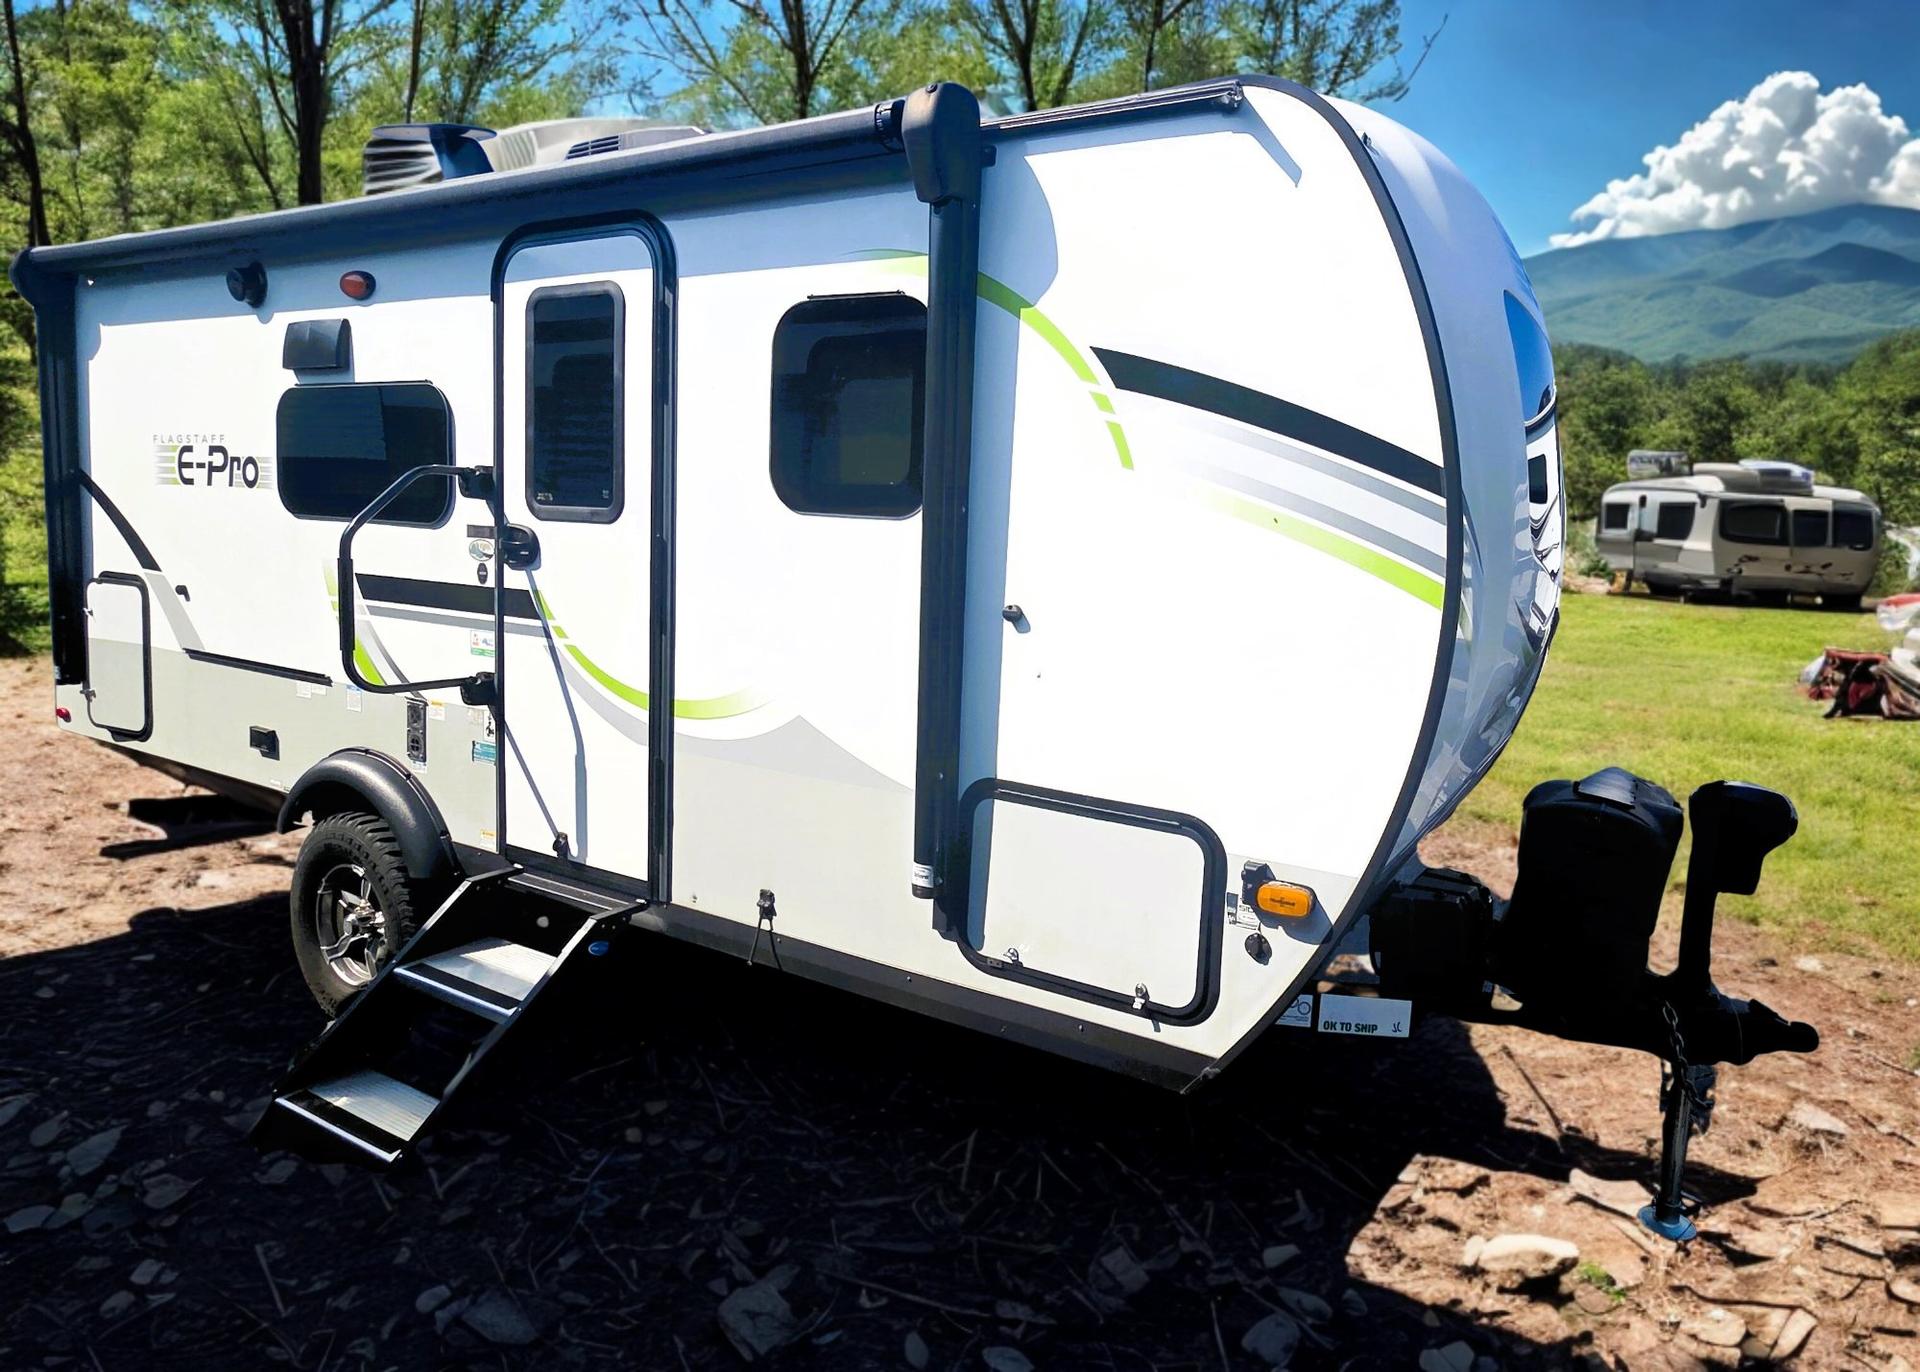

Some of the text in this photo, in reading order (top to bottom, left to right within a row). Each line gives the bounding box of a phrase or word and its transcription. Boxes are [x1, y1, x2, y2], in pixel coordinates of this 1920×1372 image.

[152, 434, 225, 443] FLAGSTAFF
[177, 445, 259, 489] E-Pro
[1323, 1020, 1378, 1034] OK TO SHIP
